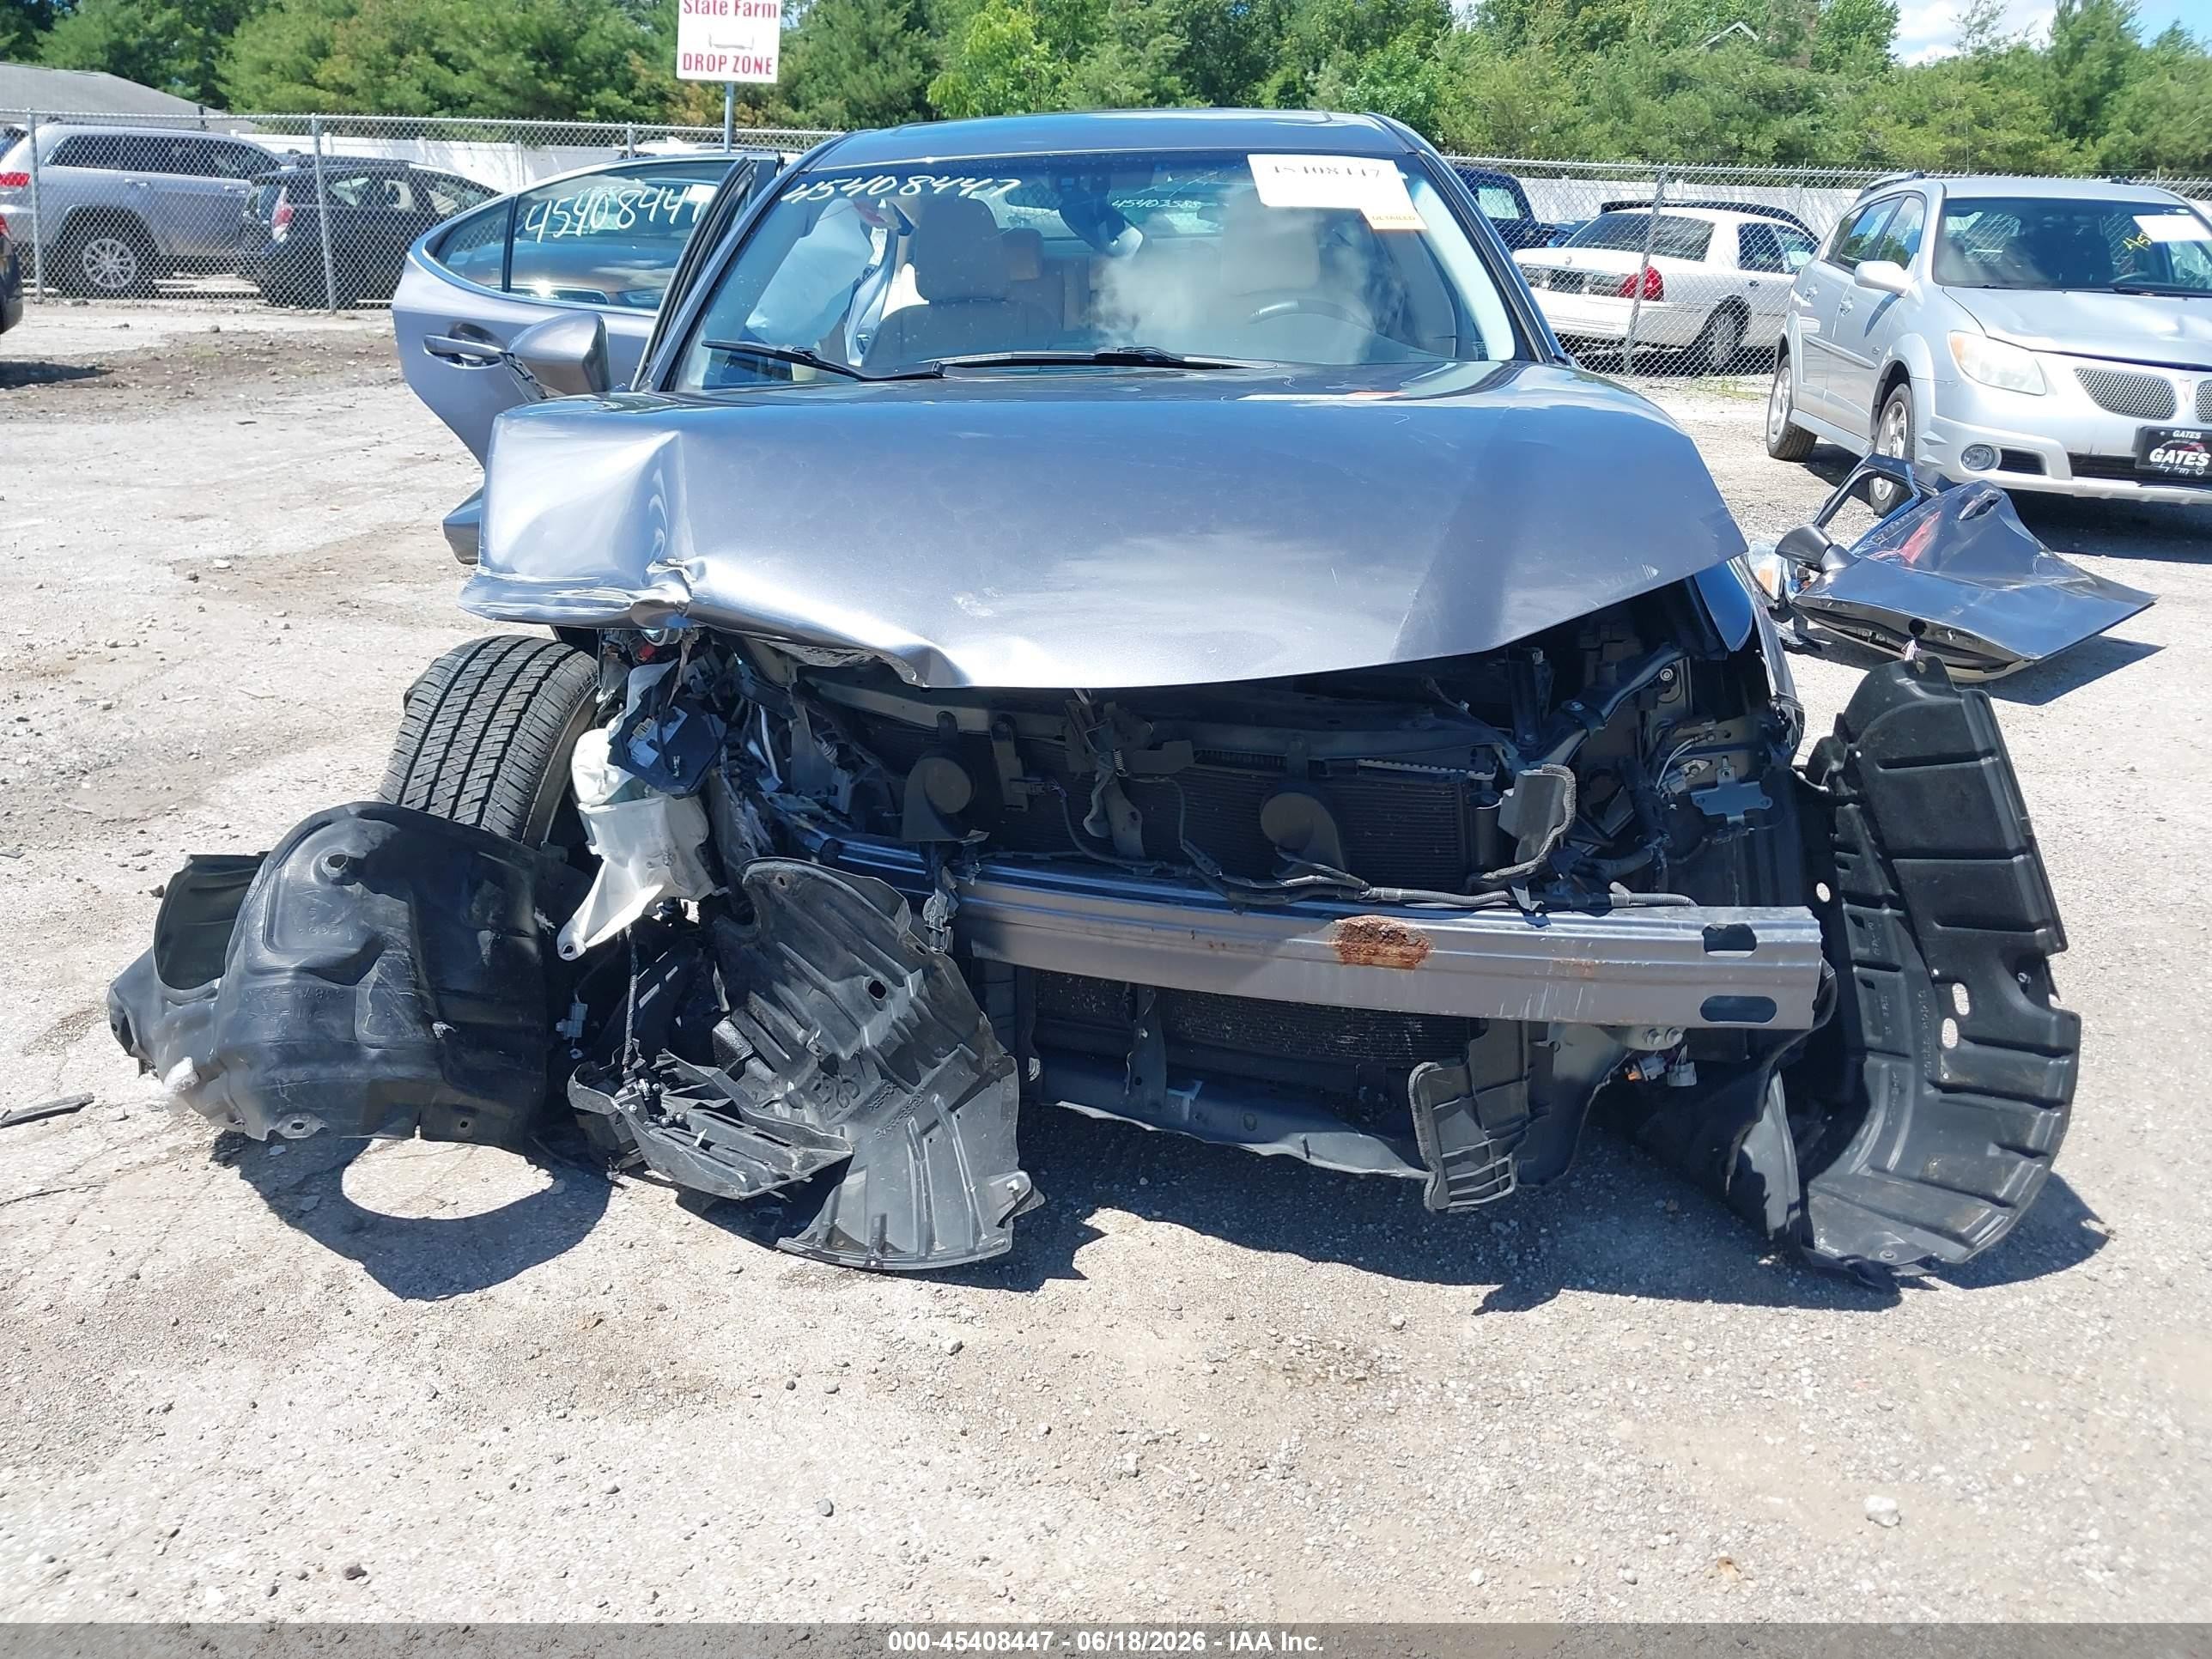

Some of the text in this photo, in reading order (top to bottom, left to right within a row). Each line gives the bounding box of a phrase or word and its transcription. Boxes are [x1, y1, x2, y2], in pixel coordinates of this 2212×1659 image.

[684, 0, 777, 18] State Farm
[683, 53, 773, 75] DROP ZONE
[781, 174, 1023, 204] 45408447
[2172, 430, 2203, 440] GATES
[2149, 447, 2211, 467] GATES
